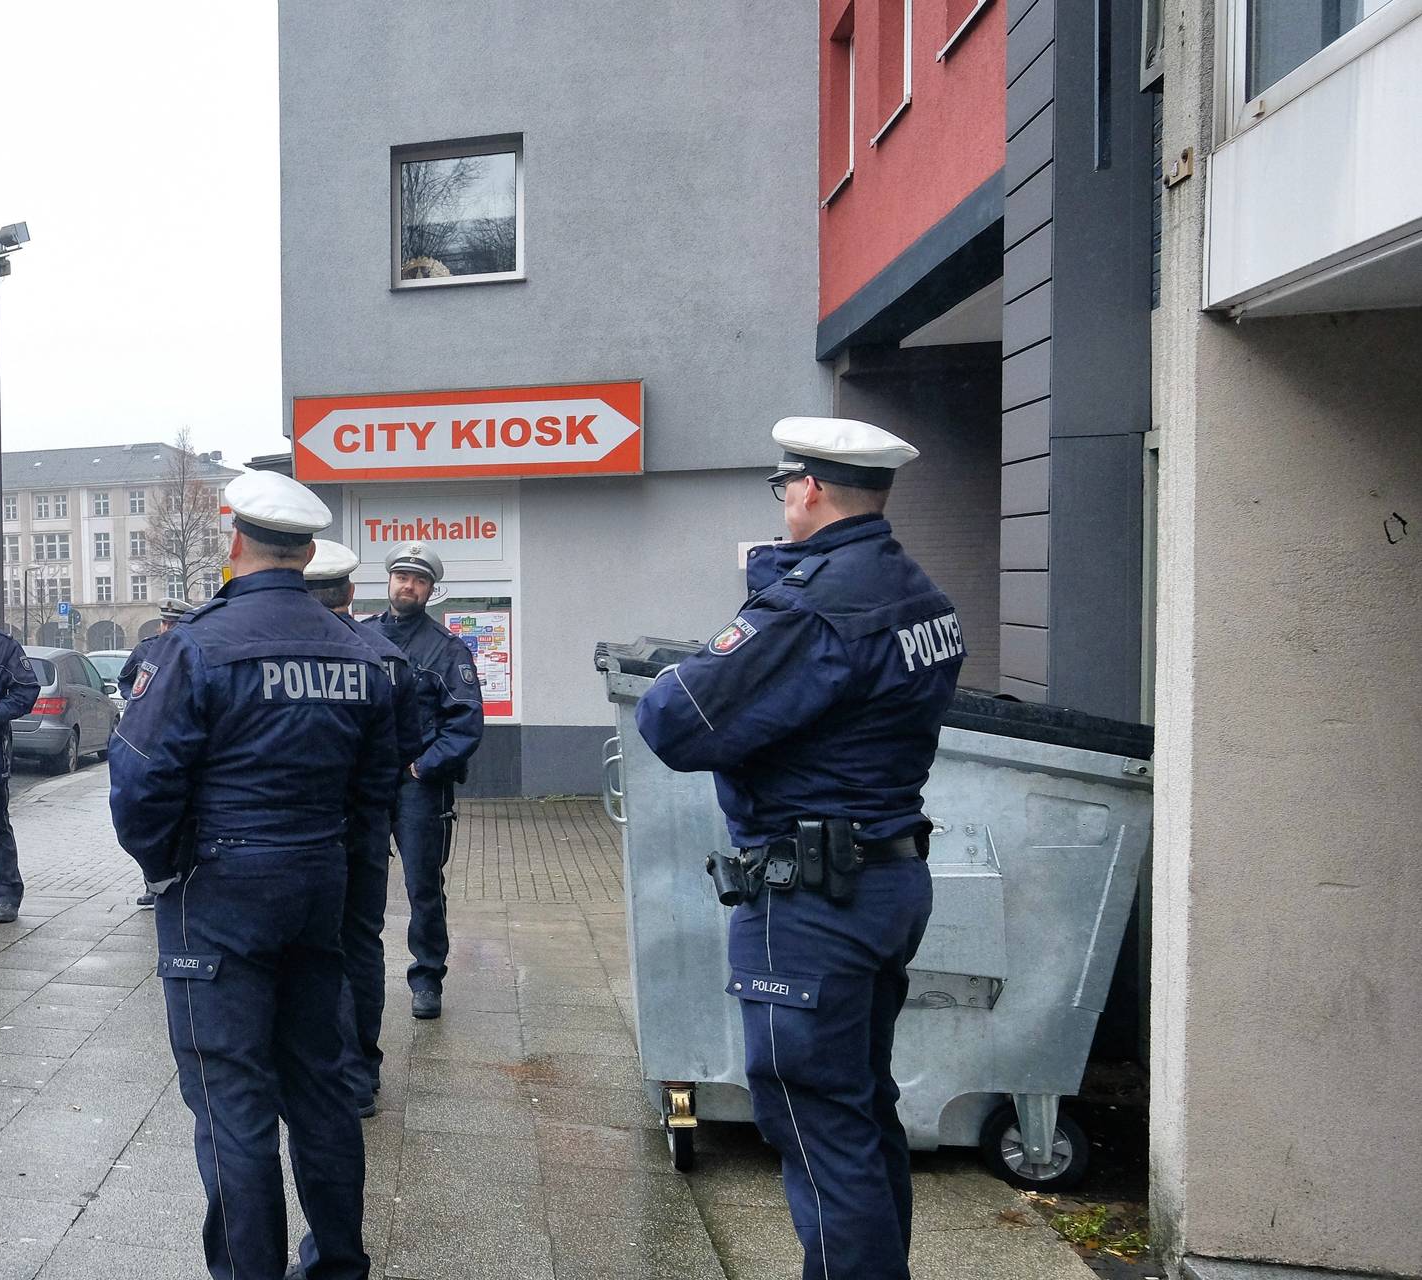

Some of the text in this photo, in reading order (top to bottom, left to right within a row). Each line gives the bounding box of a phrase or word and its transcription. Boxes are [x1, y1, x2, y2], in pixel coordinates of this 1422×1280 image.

[333, 414, 599, 453] CITY KIOSK
[364, 516, 498, 542] Trinkhalle
[262, 661, 367, 701] POLIZEI
[172, 958, 200, 969] POLIZEI
[752, 979, 790, 996] POLIZEI
